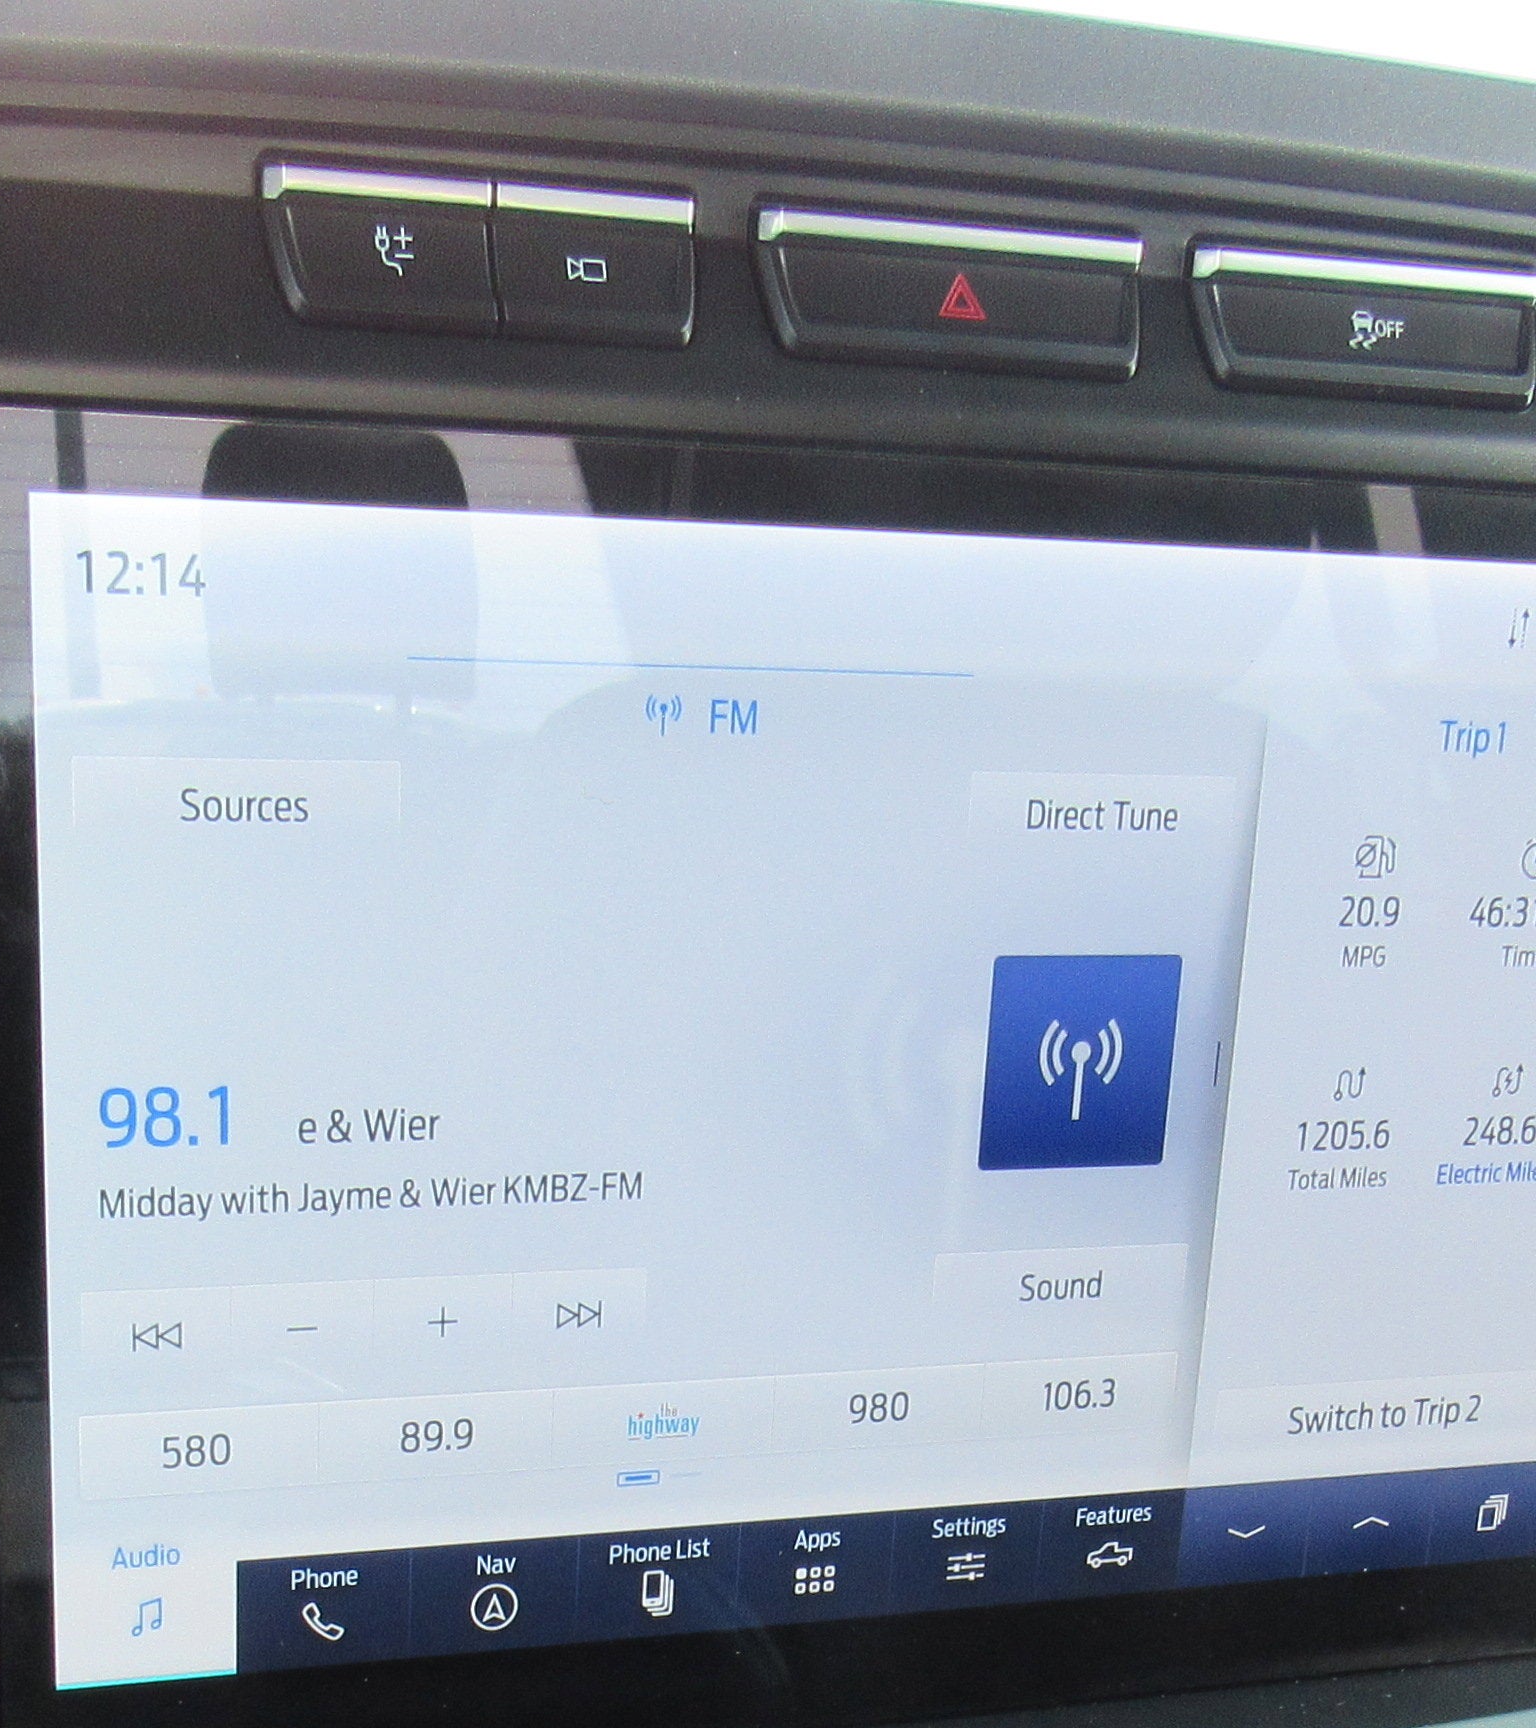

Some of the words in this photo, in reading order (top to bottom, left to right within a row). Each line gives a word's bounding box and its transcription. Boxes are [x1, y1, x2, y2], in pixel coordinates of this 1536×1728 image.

[1375, 319, 1404, 339] OFF
[75, 549, 207, 597] 12:14
[709, 698, 759, 735] FM
[179, 787, 310, 824] Sources
[1026, 798, 1105, 832] Direct
[1114, 800, 1178, 833] Tune
[1338, 895, 1401, 928] 20.9
[1341, 945, 1387, 969] MPG
[97, 1084, 233, 1148] 98.1
[297, 1114, 317, 1145] e
[326, 1110, 353, 1143] &
[364, 1107, 440, 1142] Wier
[1295, 1119, 1391, 1152] 1205.6
[1287, 1167, 1336, 1191] Total
[1340, 1165, 1387, 1190] Miles
[1436, 1161, 1501, 1186] Electric
[98, 1186, 211, 1223] Midday
[220, 1182, 289, 1216] with
[296, 1180, 392, 1217] Jayme
[399, 1179, 422, 1209] &
[431, 1175, 495, 1208] Wier
[503, 1171, 644, 1205] KMBZ-FM
[1018, 1269, 1103, 1303] Sound
[660, 1402, 678, 1417] the
[848, 1390, 910, 1425] 980
[1042, 1378, 1116, 1412] 106.3
[628, 1412, 700, 1440] highway
[1287, 1403, 1374, 1435] Switch
[1380, 1403, 1407, 1428] to
[1413, 1396, 1460, 1430] Trip
[1466, 1394, 1482, 1423] 2
[160, 1432, 232, 1471] 580
[399, 1417, 474, 1454] 89.9
[931, 1514, 1006, 1542] Settings
[1075, 1503, 1152, 1528] Features
[110, 1543, 181, 1572] Audio
[608, 1540, 672, 1566] Phone
[677, 1536, 711, 1560] List
[793, 1528, 842, 1554] Apps
[290, 1565, 359, 1592] Phone
[475, 1553, 517, 1577] Nav
